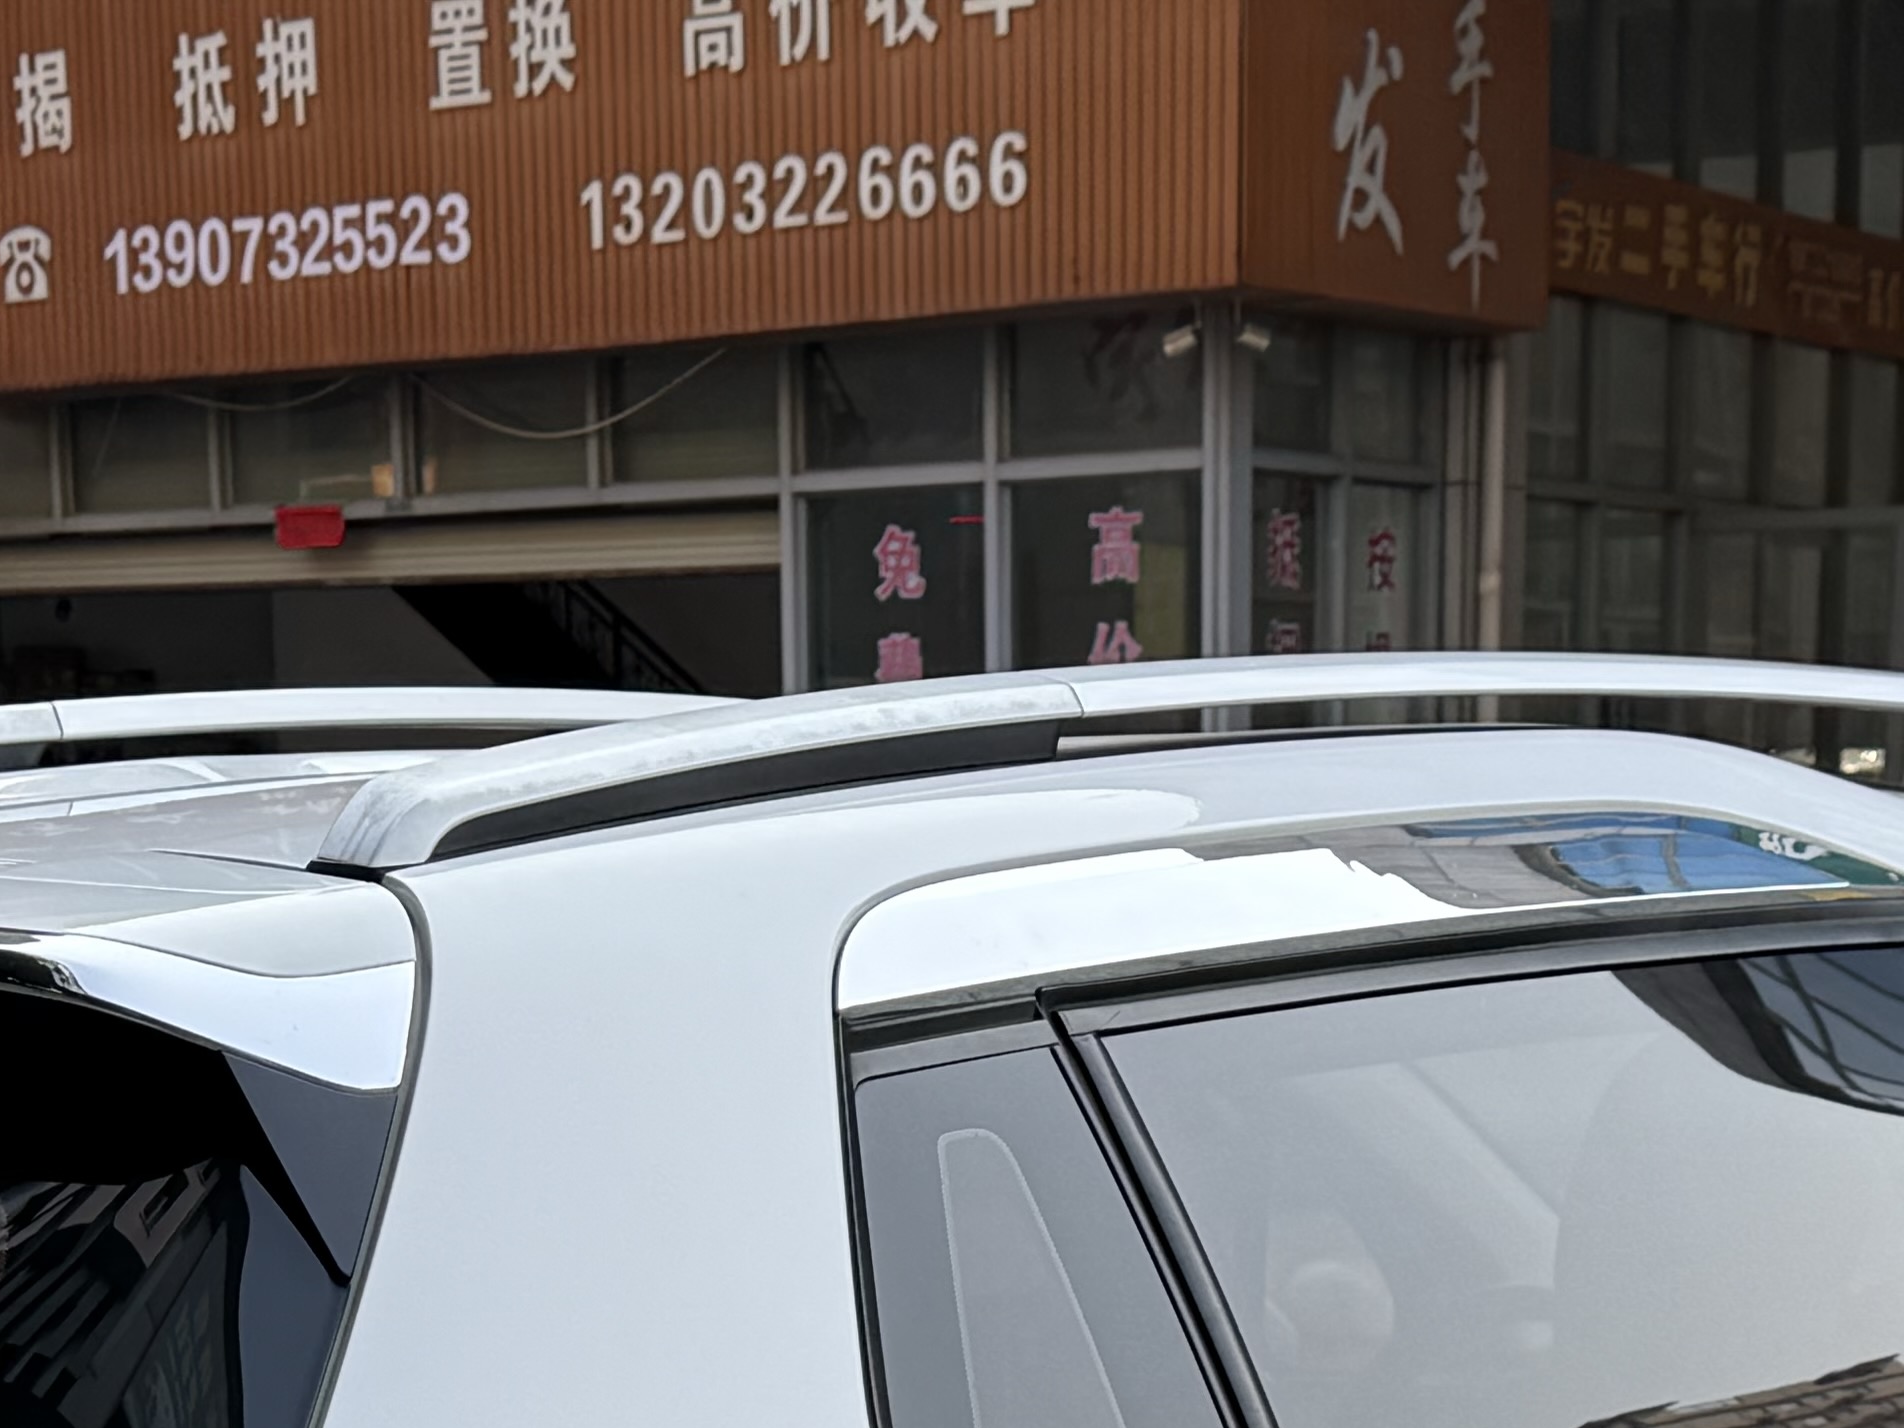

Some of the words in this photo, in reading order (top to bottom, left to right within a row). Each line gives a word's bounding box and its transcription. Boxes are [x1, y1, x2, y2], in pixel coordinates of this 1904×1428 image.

[173, 17, 318, 142] 抵押
[429, 0, 577, 110] 置换
[103, 193, 472, 295] 13907325523
[580, 129, 1029, 252] 13203226666
